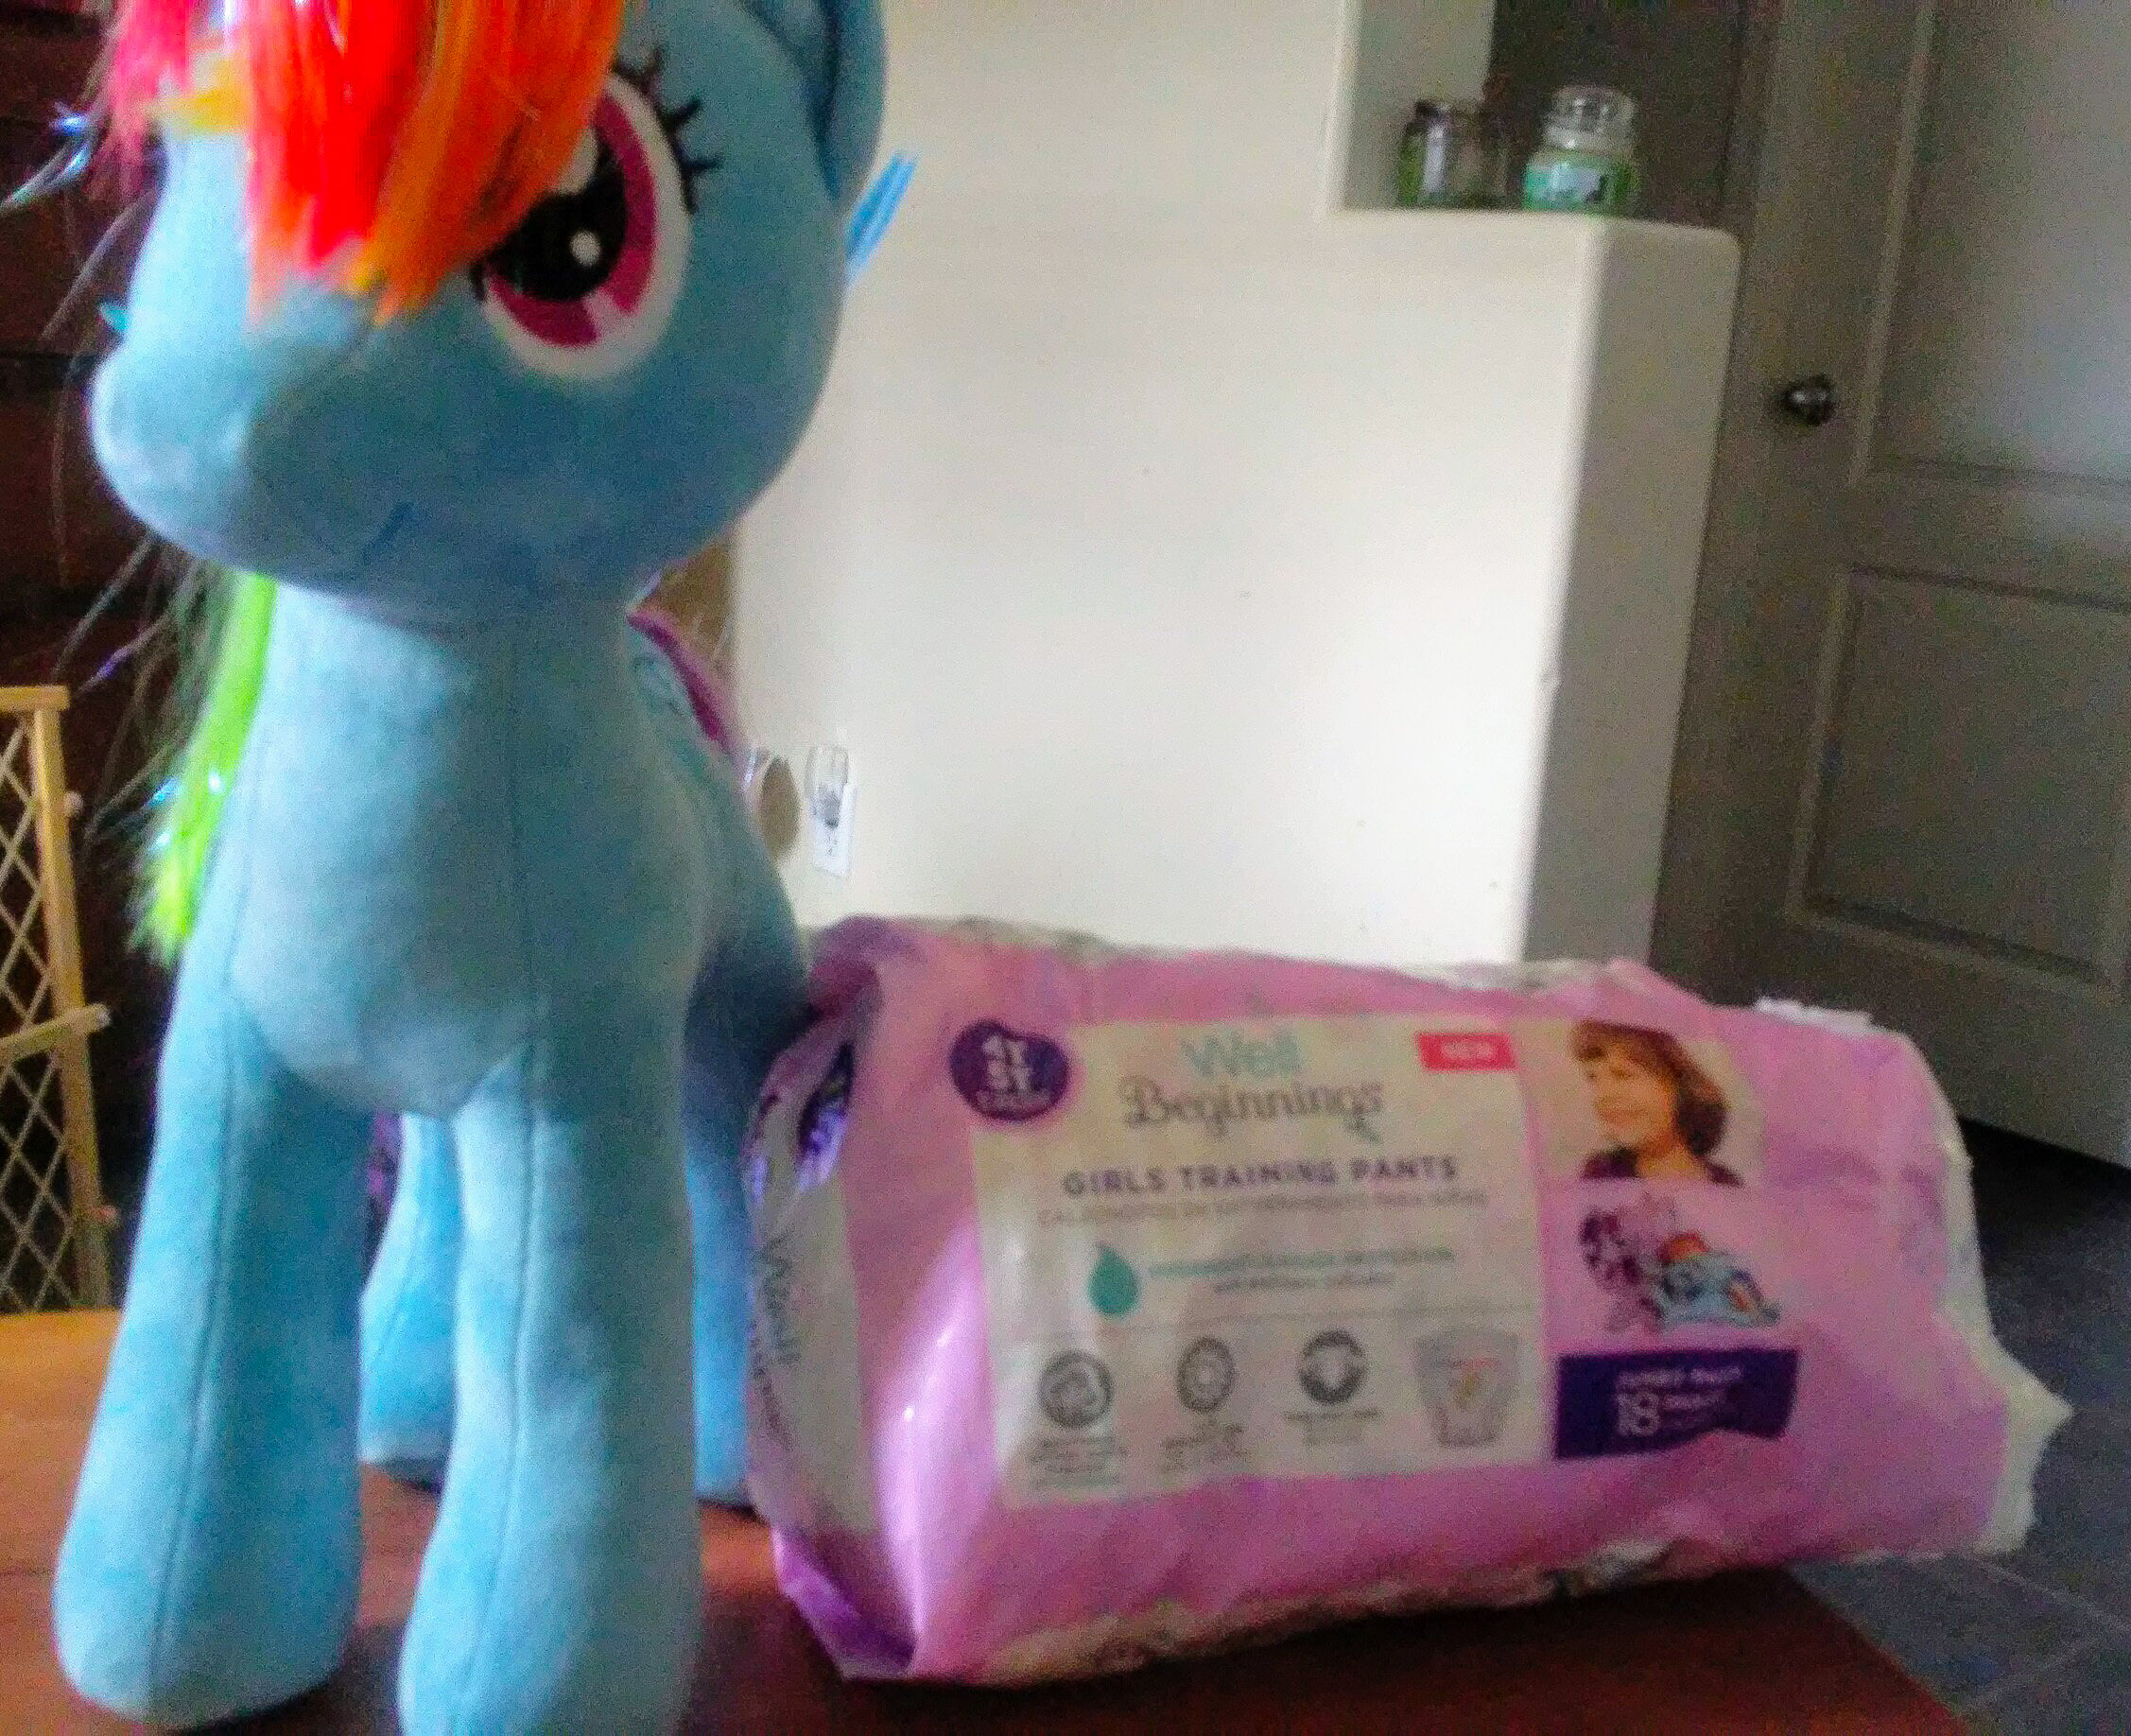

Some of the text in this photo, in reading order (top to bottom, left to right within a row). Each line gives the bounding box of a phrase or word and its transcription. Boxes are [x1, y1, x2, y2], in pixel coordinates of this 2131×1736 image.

[1119, 1076, 1384, 1143] Beginnings
[1062, 1155, 1459, 1197] GIRLS TRAINING PANTS
